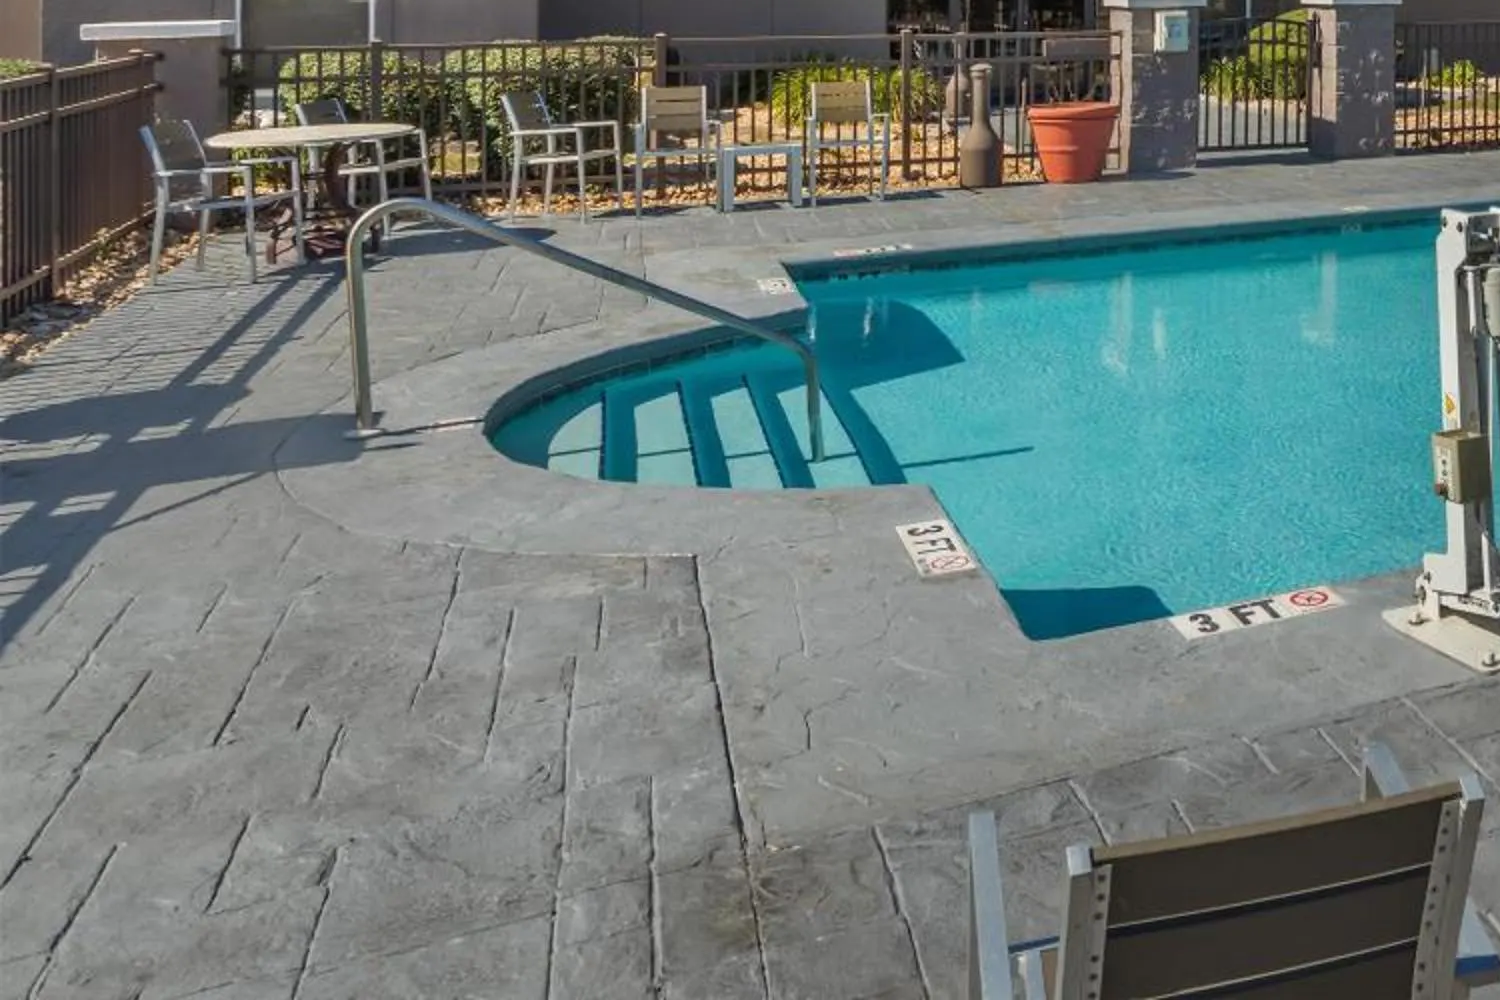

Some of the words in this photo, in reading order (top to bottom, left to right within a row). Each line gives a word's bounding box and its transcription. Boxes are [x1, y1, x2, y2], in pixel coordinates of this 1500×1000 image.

[907, 525, 944, 536] 3
[913, 538, 957, 554] FT
[1189, 613, 1220, 633] 3
[1229, 599, 1281, 625] FT
